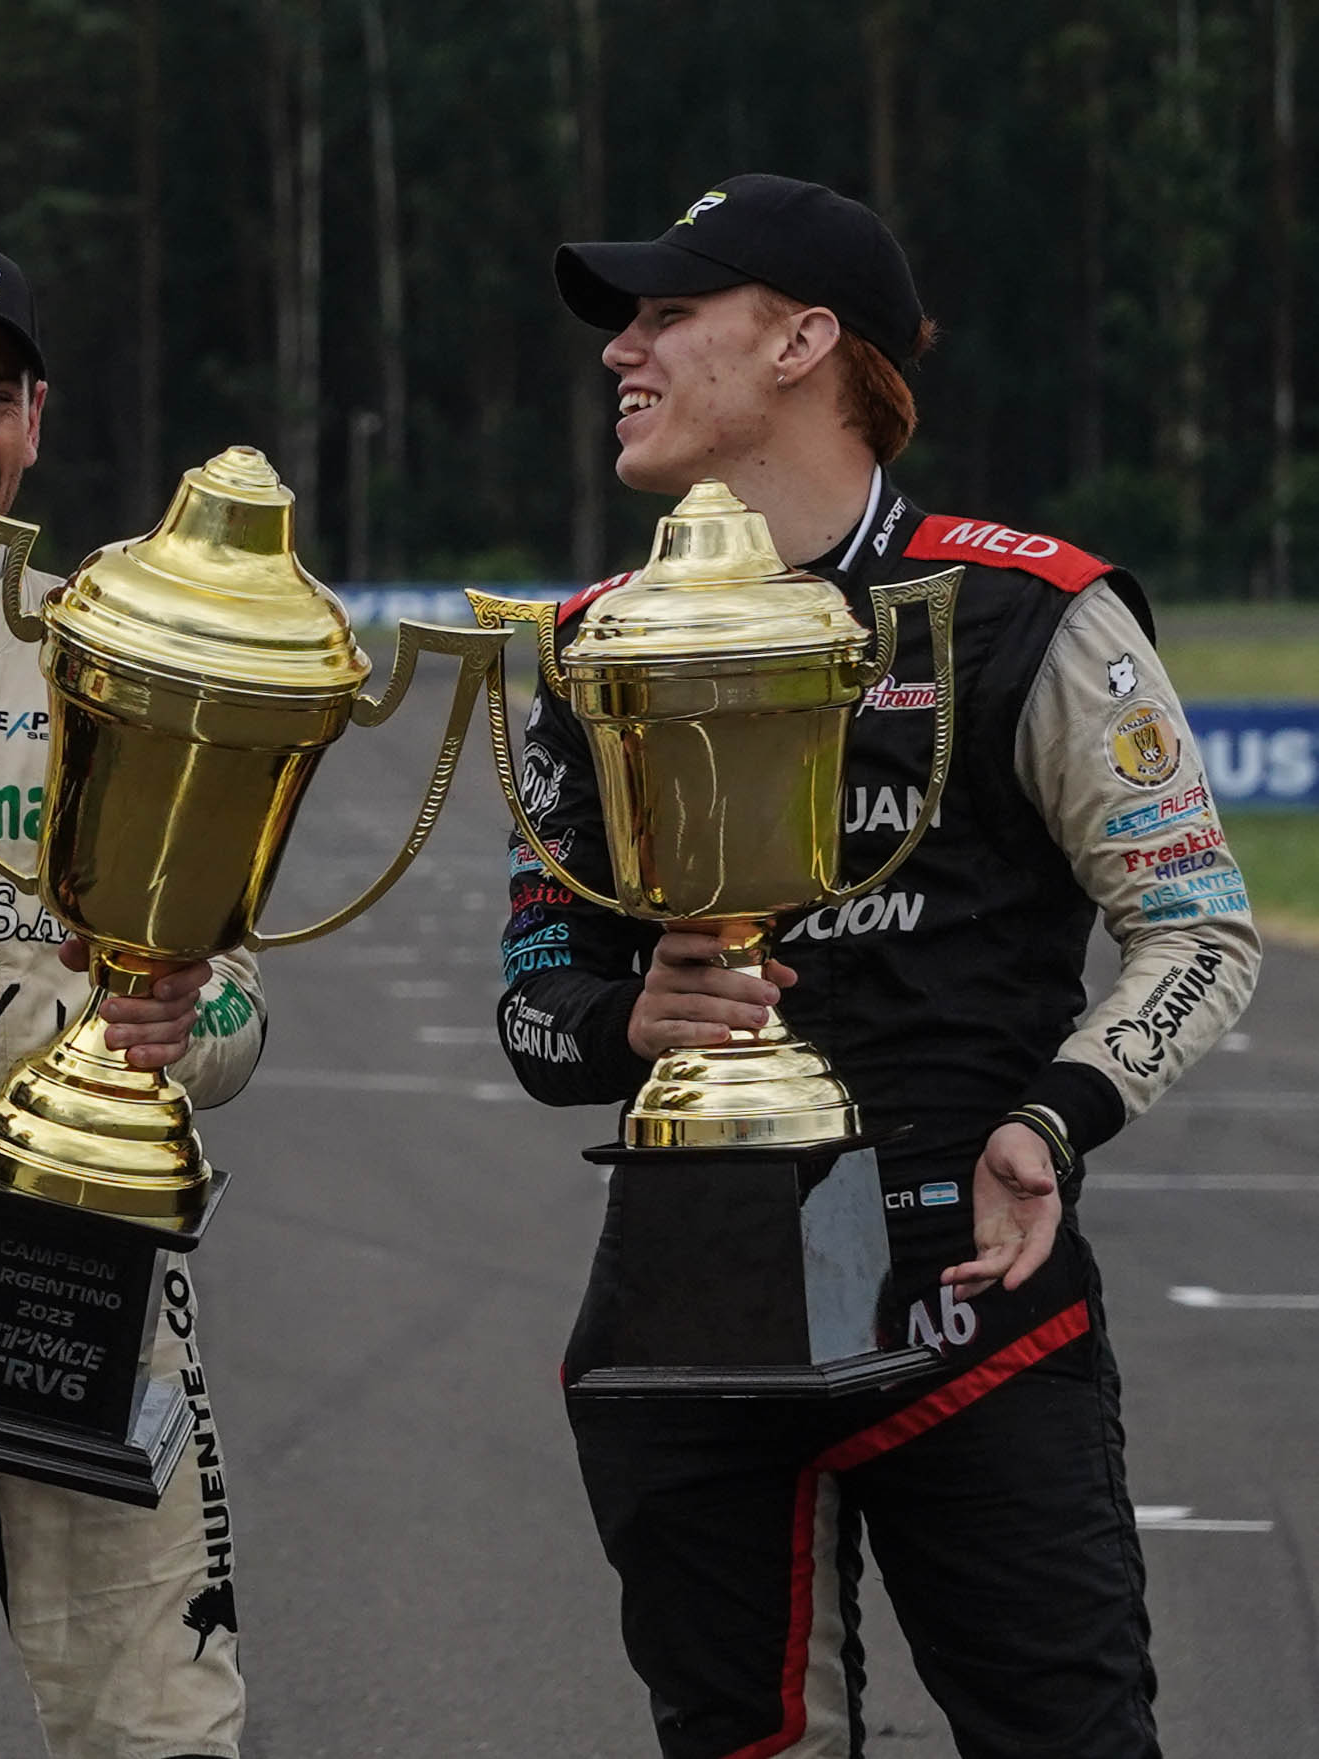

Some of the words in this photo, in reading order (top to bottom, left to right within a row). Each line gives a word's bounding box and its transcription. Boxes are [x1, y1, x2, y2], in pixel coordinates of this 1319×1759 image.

[941, 522, 1059, 559] MED
[27, 732, 49, 741] SE
[845, 785, 941, 834] UAN
[1155, 851, 1216, 881] HIELO
[781, 882, 925, 943] CIÓN
[885, 1190, 914, 1209] CA
[0, 1239, 117, 1281] CAMPEON
[16, 1299, 77, 1328] 2023
